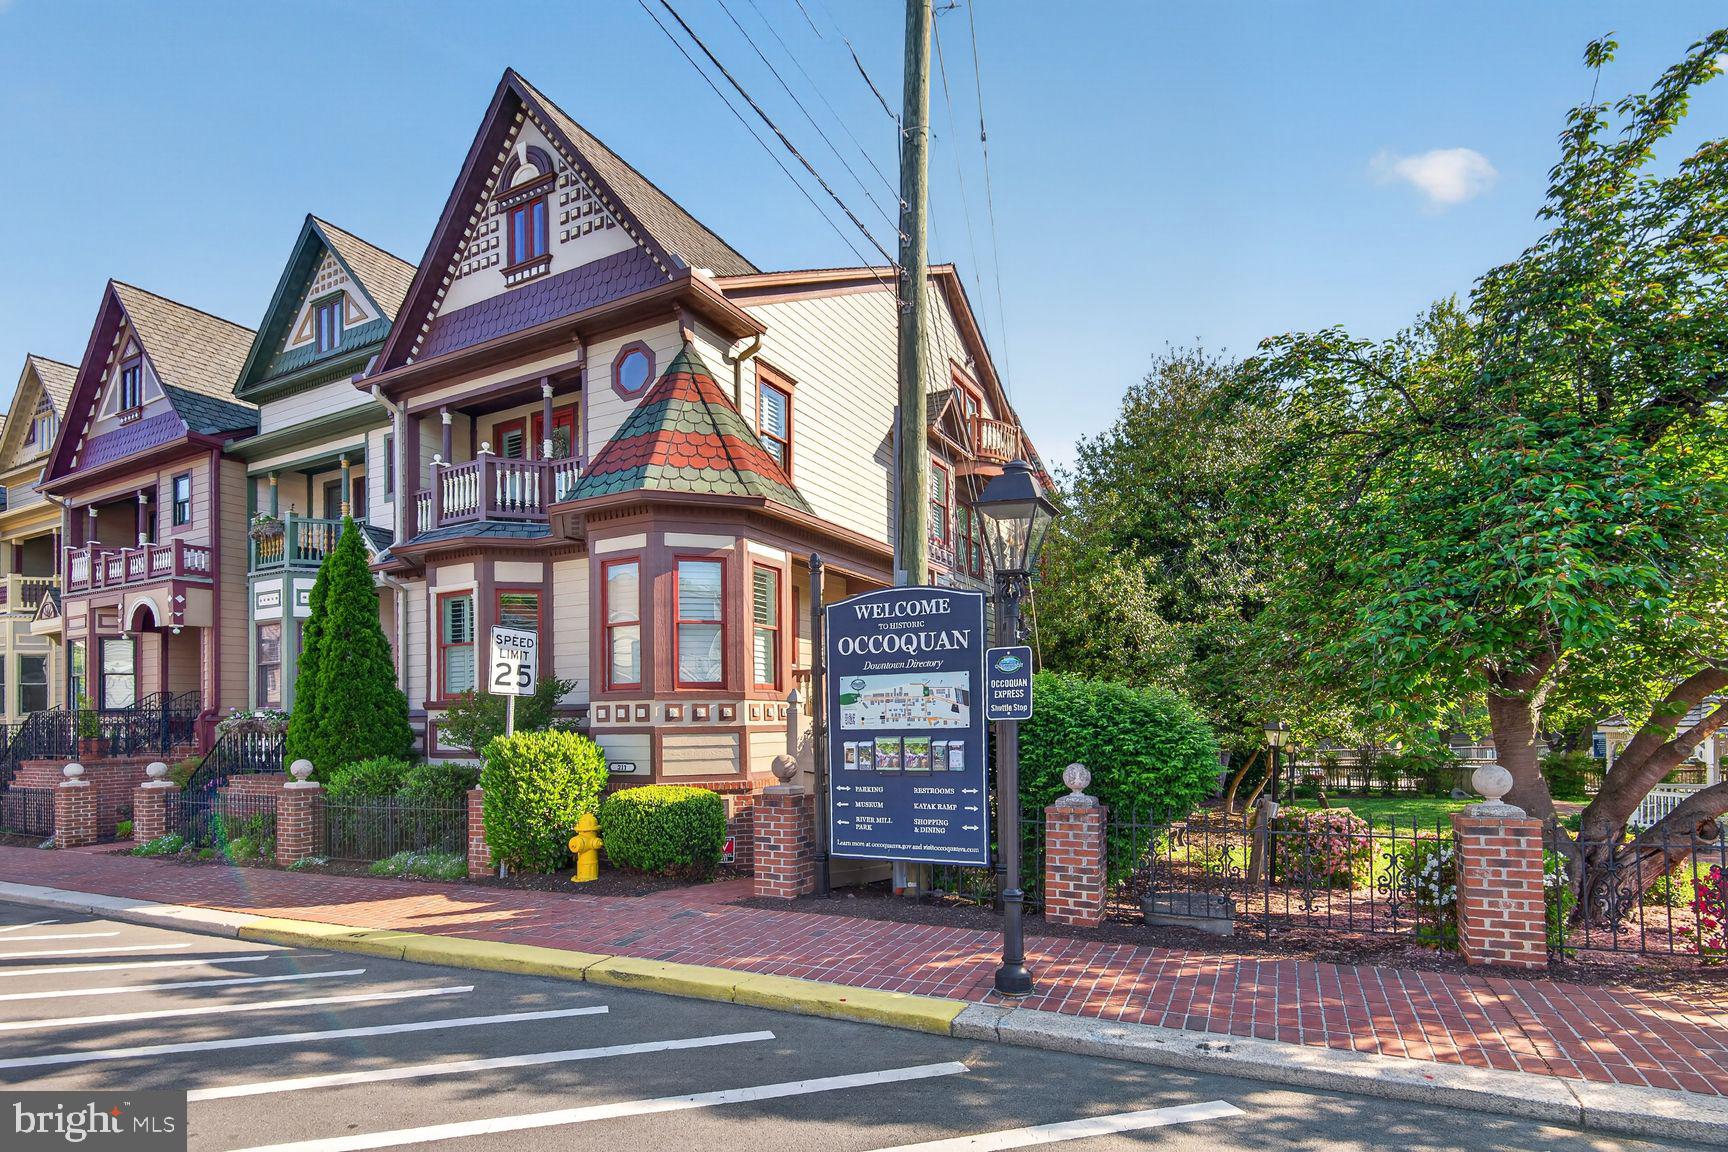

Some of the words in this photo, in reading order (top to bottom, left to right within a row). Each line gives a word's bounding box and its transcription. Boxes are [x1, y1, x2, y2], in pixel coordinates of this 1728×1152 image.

[854, 598, 951, 620] WELCOME
[890, 621, 925, 630] HISTORIC
[496, 634, 534, 648] SPEED
[838, 629, 971, 656] OCCOQUAN
[500, 648, 530, 661] LIMIT
[862, 661, 905, 671] Downtown
[905, 658, 944, 670] Directory
[495, 662, 532, 688] 25
[991, 678, 1028, 689] OCCOQUAN
[994, 690, 1025, 699] EXPRESS
[990, 703, 1013, 712] Shuttle
[1013, 703, 1028, 713] Stop
[913, 787, 955, 795] RESTROOMS
[913, 802, 936, 810] KAYAK
[937, 803, 958, 811] RAMP
[913, 818, 949, 826] SHOPPING
